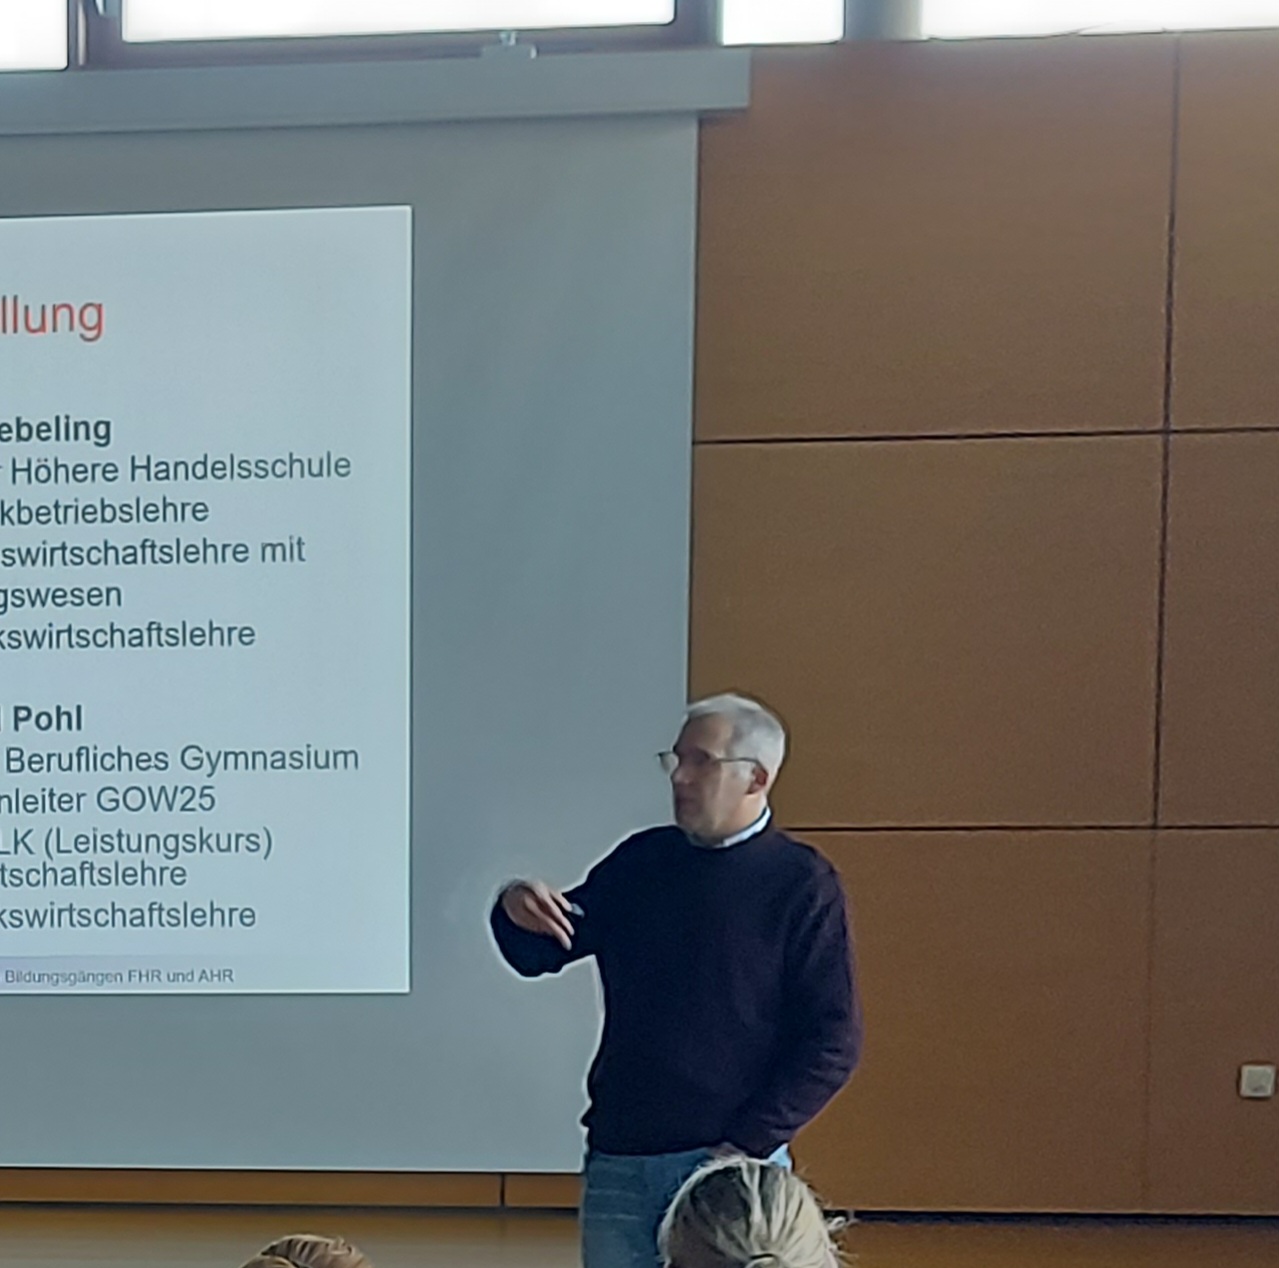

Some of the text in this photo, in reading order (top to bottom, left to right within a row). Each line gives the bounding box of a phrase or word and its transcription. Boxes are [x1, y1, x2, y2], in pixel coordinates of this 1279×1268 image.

[12, 457, 119, 484] Höhere
[130, 451, 352, 482] Handelsschule
[261, 536, 306, 563] mit
[13, 704, 83, 732] Pohl
[6, 745, 169, 774] Berufliches
[180, 744, 359, 777] Gymnasium
[96, 785, 216, 813] GOW25
[45, 826, 273, 860] (Leistungskurs)
[5, 968, 123, 987] Bildungsgängen
[128, 969, 161, 983] FHR
[167, 968, 194, 983] und
[198, 968, 234, 983] AHR
